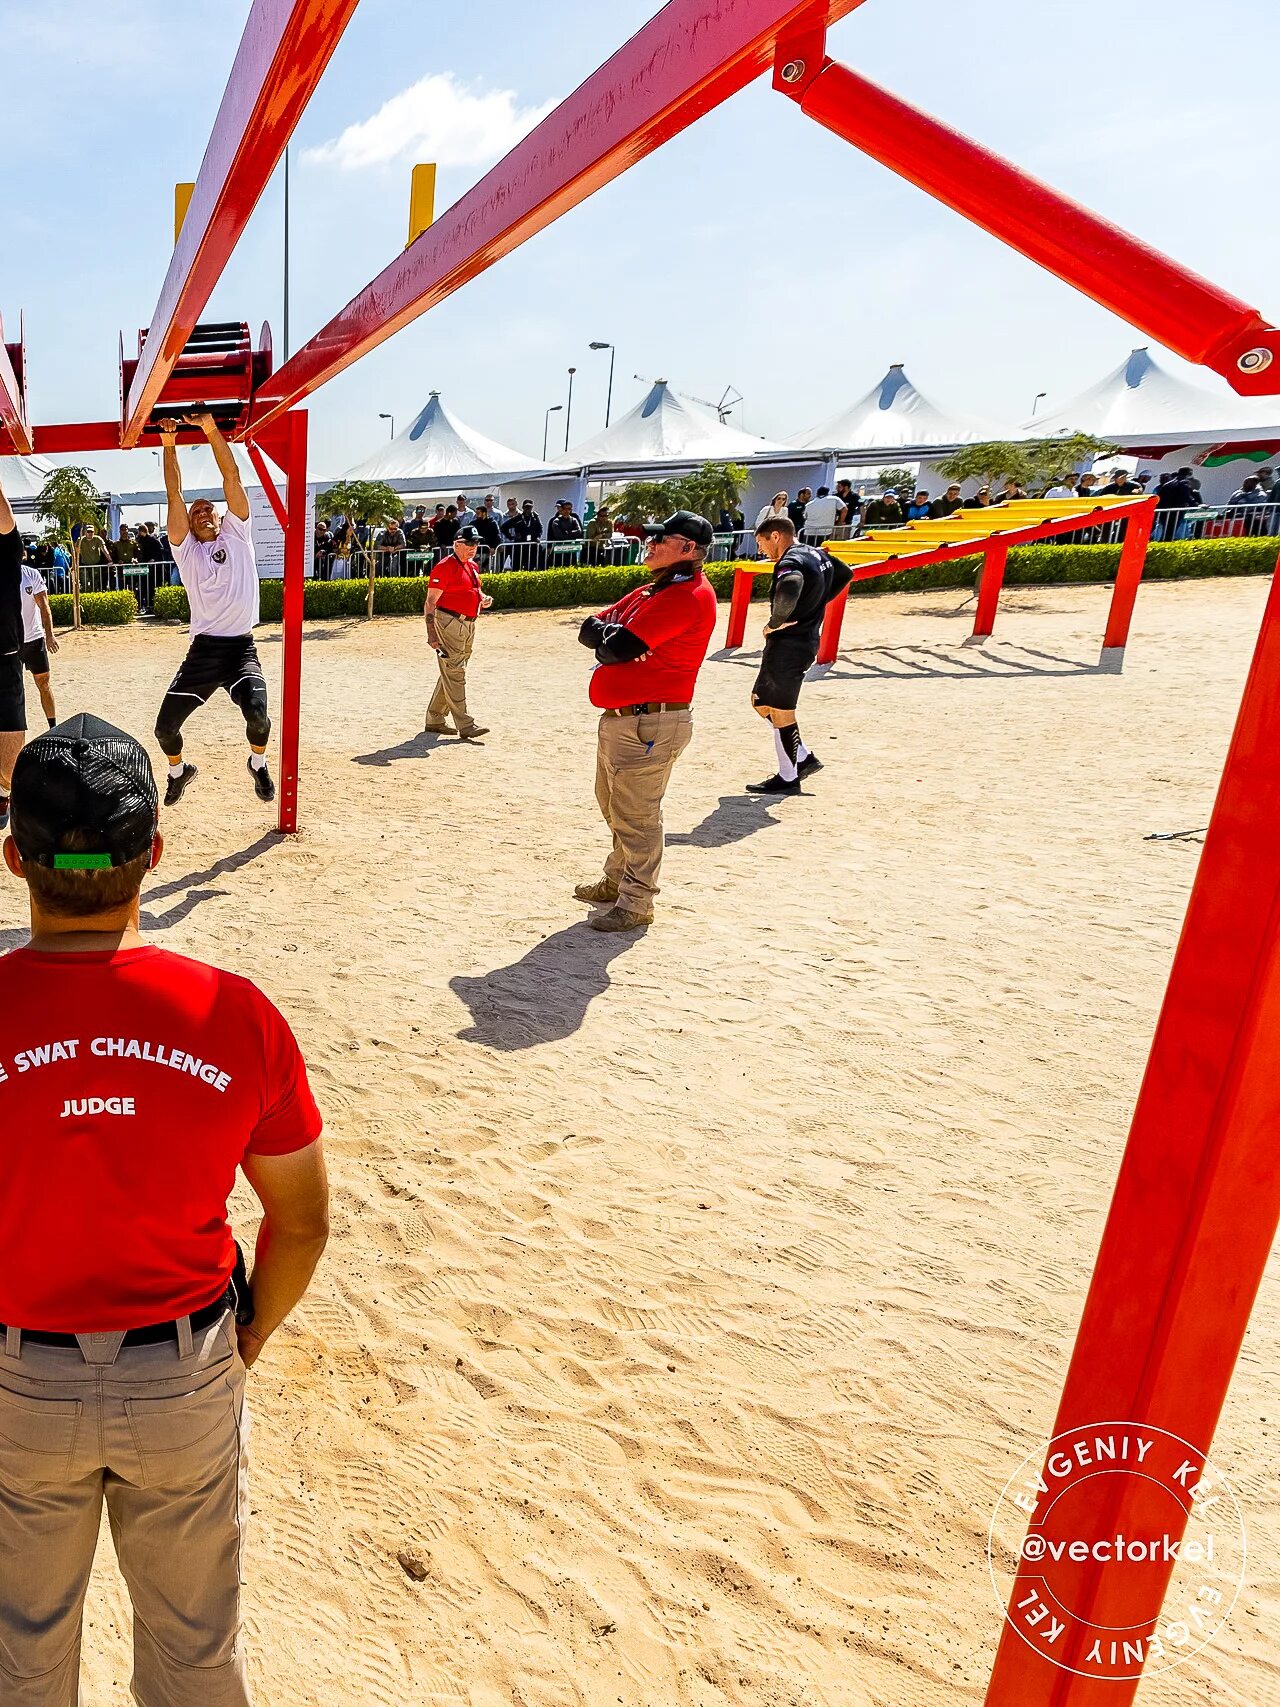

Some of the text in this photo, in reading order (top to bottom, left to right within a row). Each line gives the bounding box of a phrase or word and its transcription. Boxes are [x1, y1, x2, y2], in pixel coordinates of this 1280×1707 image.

[13, 1039, 80, 1074] SWAT
[90, 1037, 233, 1093] CHALLENGE
[59, 1097, 136, 1118] JUDGE
